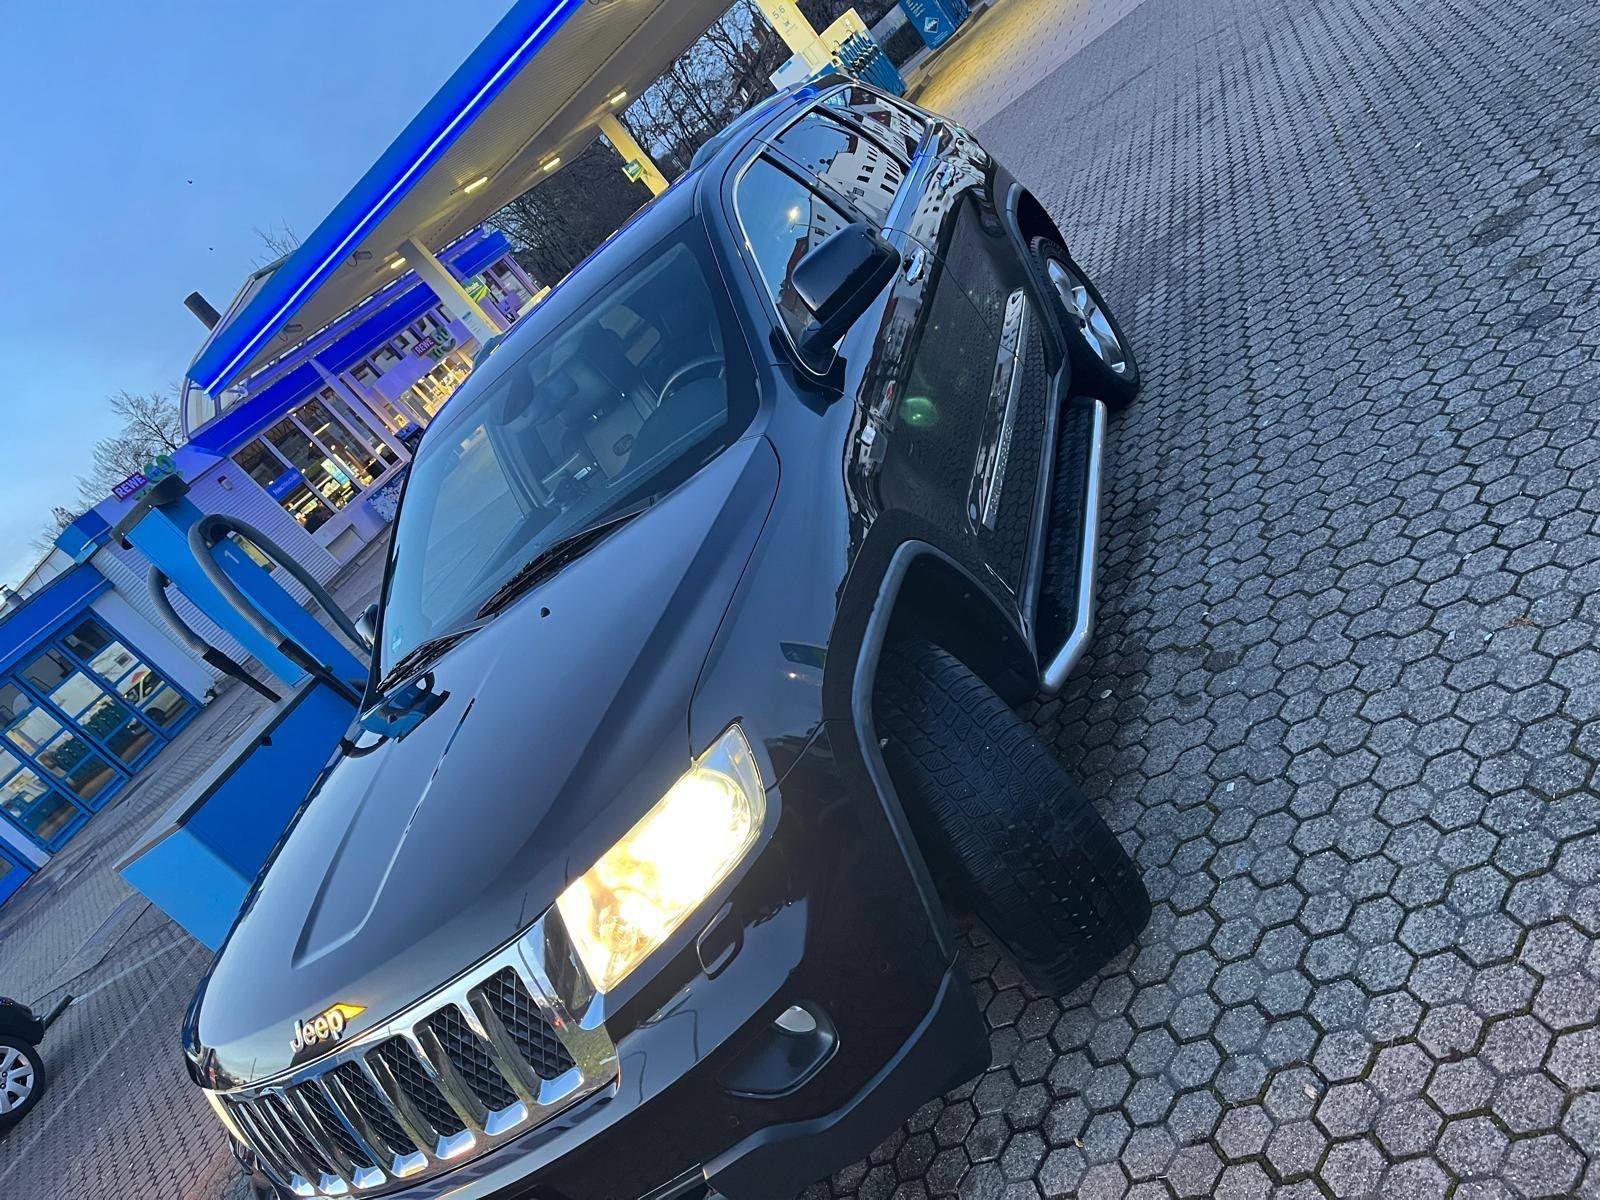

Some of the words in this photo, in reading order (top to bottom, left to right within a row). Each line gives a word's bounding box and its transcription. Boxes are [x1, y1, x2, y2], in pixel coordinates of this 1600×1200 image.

[414, 337, 435, 355] REWE
[114, 473, 147, 498] REWE
[224, 549, 240, 565] 1
[289, 1008, 345, 1053] Jeep
